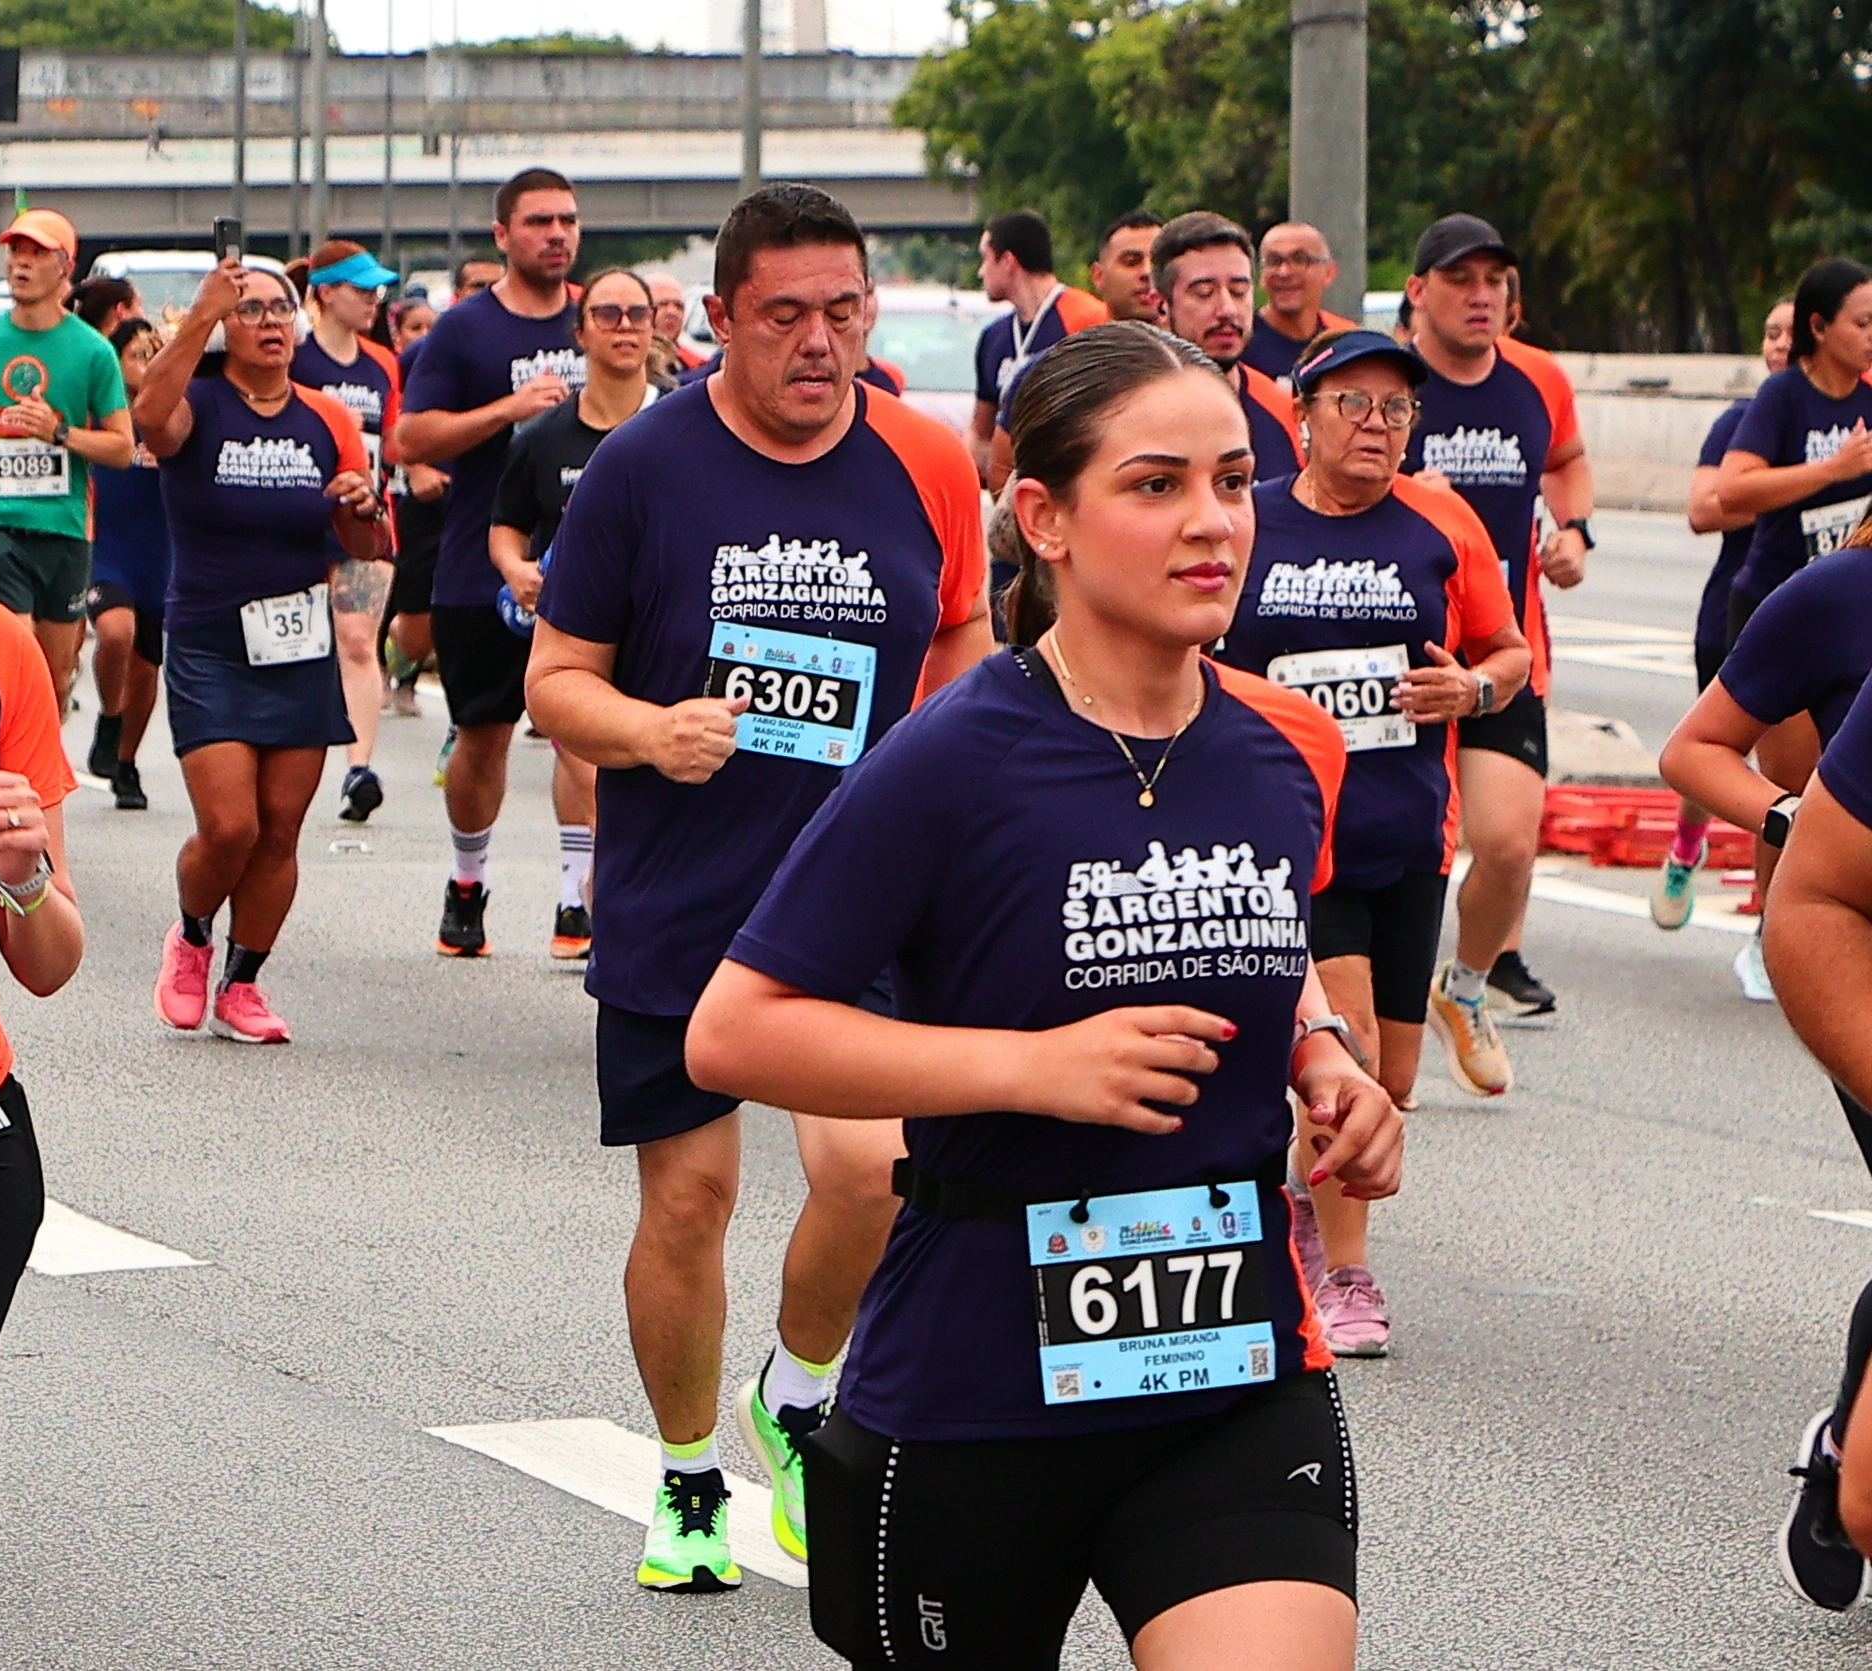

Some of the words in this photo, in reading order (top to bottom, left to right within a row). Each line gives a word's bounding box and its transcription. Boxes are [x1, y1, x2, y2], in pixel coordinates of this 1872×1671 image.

[0, 455, 53, 477] 9089
[219, 452, 299, 466] SARGENTO
[216, 463, 322, 477] GONZAGUINHA
[214, 475, 259, 486] CORRIDA
[261, 477, 274, 488] DE
[711, 563, 848, 586] SARGENTO
[1264, 575, 1381, 593] SARGENTO
[711, 583, 887, 606] GONZAGUINHA
[1260, 590, 1416, 607] GONZAGUINHA
[710, 603, 778, 620] CORRIDA
[780, 604, 800, 618] DE
[803, 603, 835, 621] SÃO
[837, 606, 887, 623] PAULO
[1256, 604, 1316, 617] CORRIDA
[1319, 606, 1338, 619] DE
[1342, 606, 1371, 619] SÃO
[1373, 607, 1418, 620] PAULO
[274, 610, 303, 638] 35
[725, 665, 841, 722] 6305
[1290, 679, 1384, 717] 060
[753, 727, 801, 739] MASCULINO
[779, 718, 805, 731] SOUZA
[750, 737, 770, 750] 4K
[774, 741, 796, 754] PM
[1062, 887, 1272, 930] SARGENTO
[1064, 919, 1308, 962] GONZAGUINHA
[1064, 958, 1178, 990] CORRIDA
[1182, 956, 1213, 979] DE
[1217, 950, 1260, 977] SÃO
[1263, 952, 1306, 977] PAULO
[1069, 1250, 1243, 1336] 6177
[1119, 1337, 1165, 1352] BRUNA
[1169, 1331, 1221, 1346] MIRANDA
[1144, 1350, 1205, 1366] FEMININO
[1139, 1373, 1169, 1391] 4K
[1179, 1368, 1210, 1388] PM
[918, 1594, 947, 1652] GRIT
